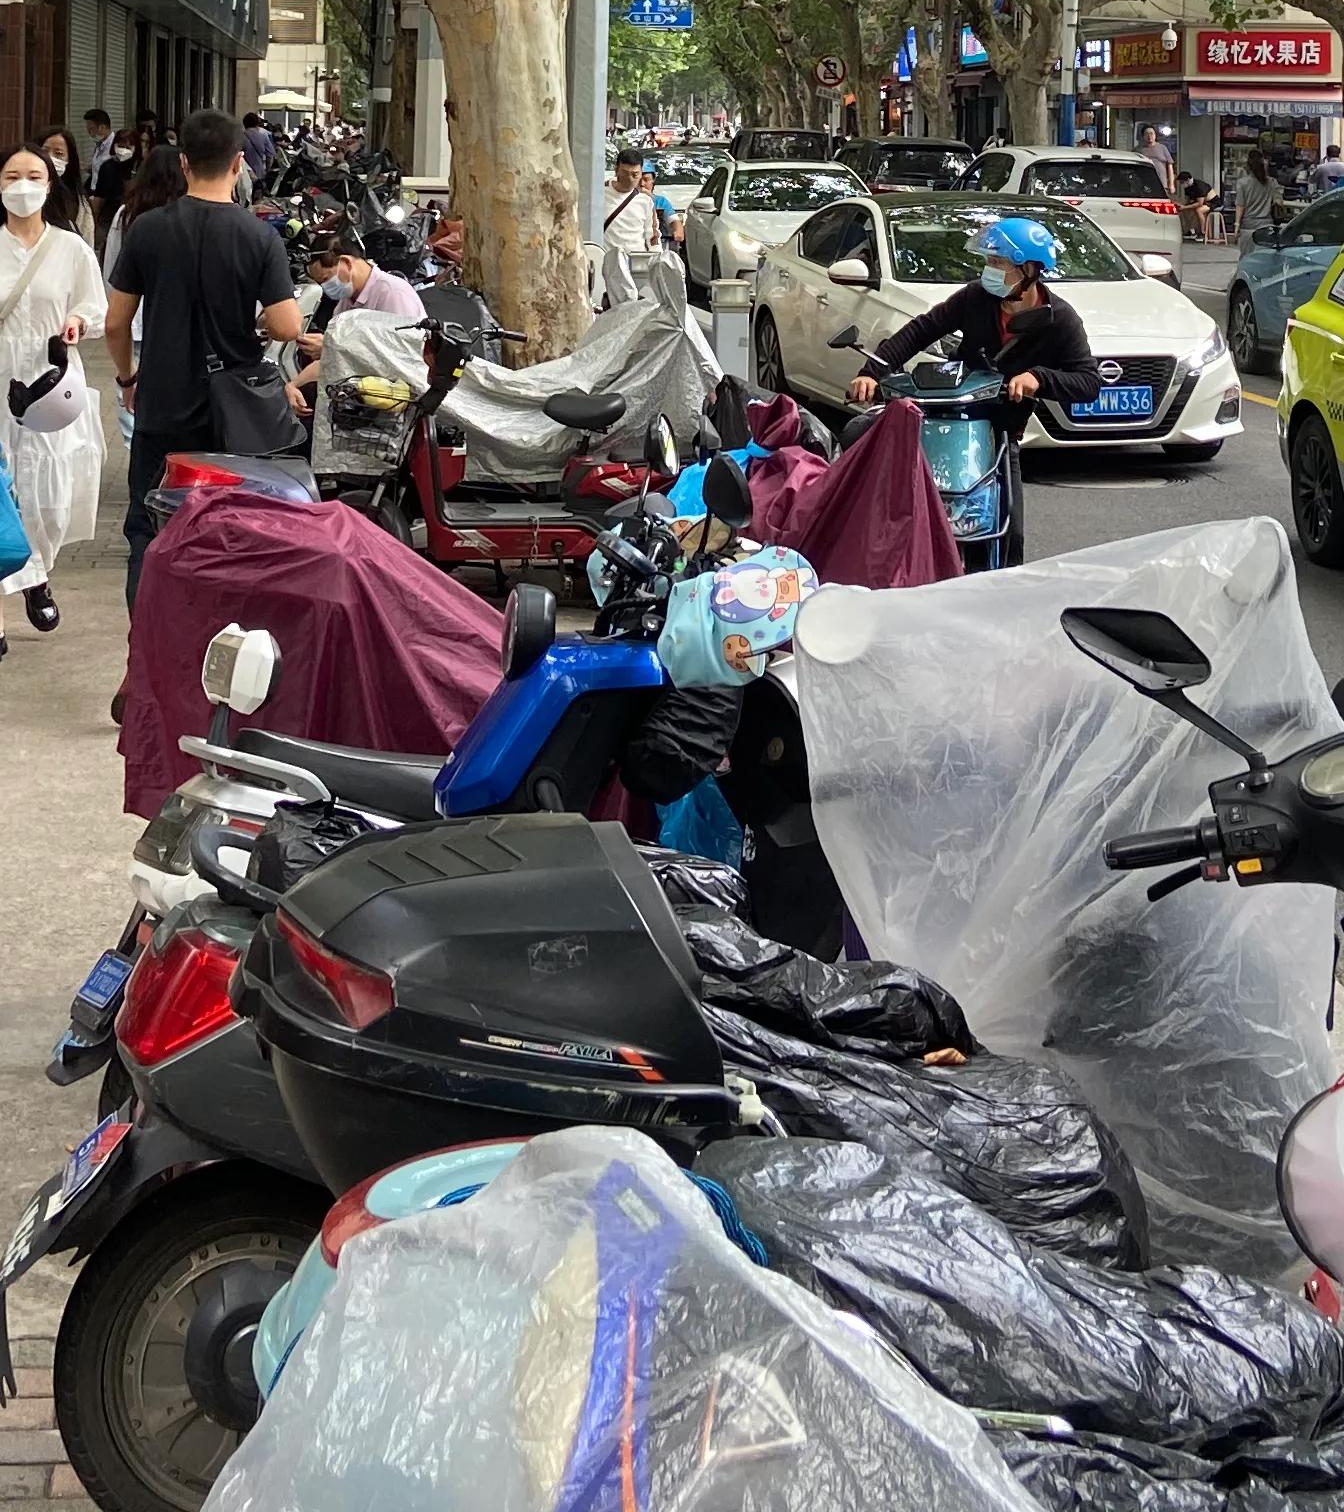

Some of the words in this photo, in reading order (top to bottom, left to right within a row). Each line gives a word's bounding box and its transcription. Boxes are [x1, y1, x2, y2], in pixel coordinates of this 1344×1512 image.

[1207, 39, 1321, 65] 缘忆水果店
